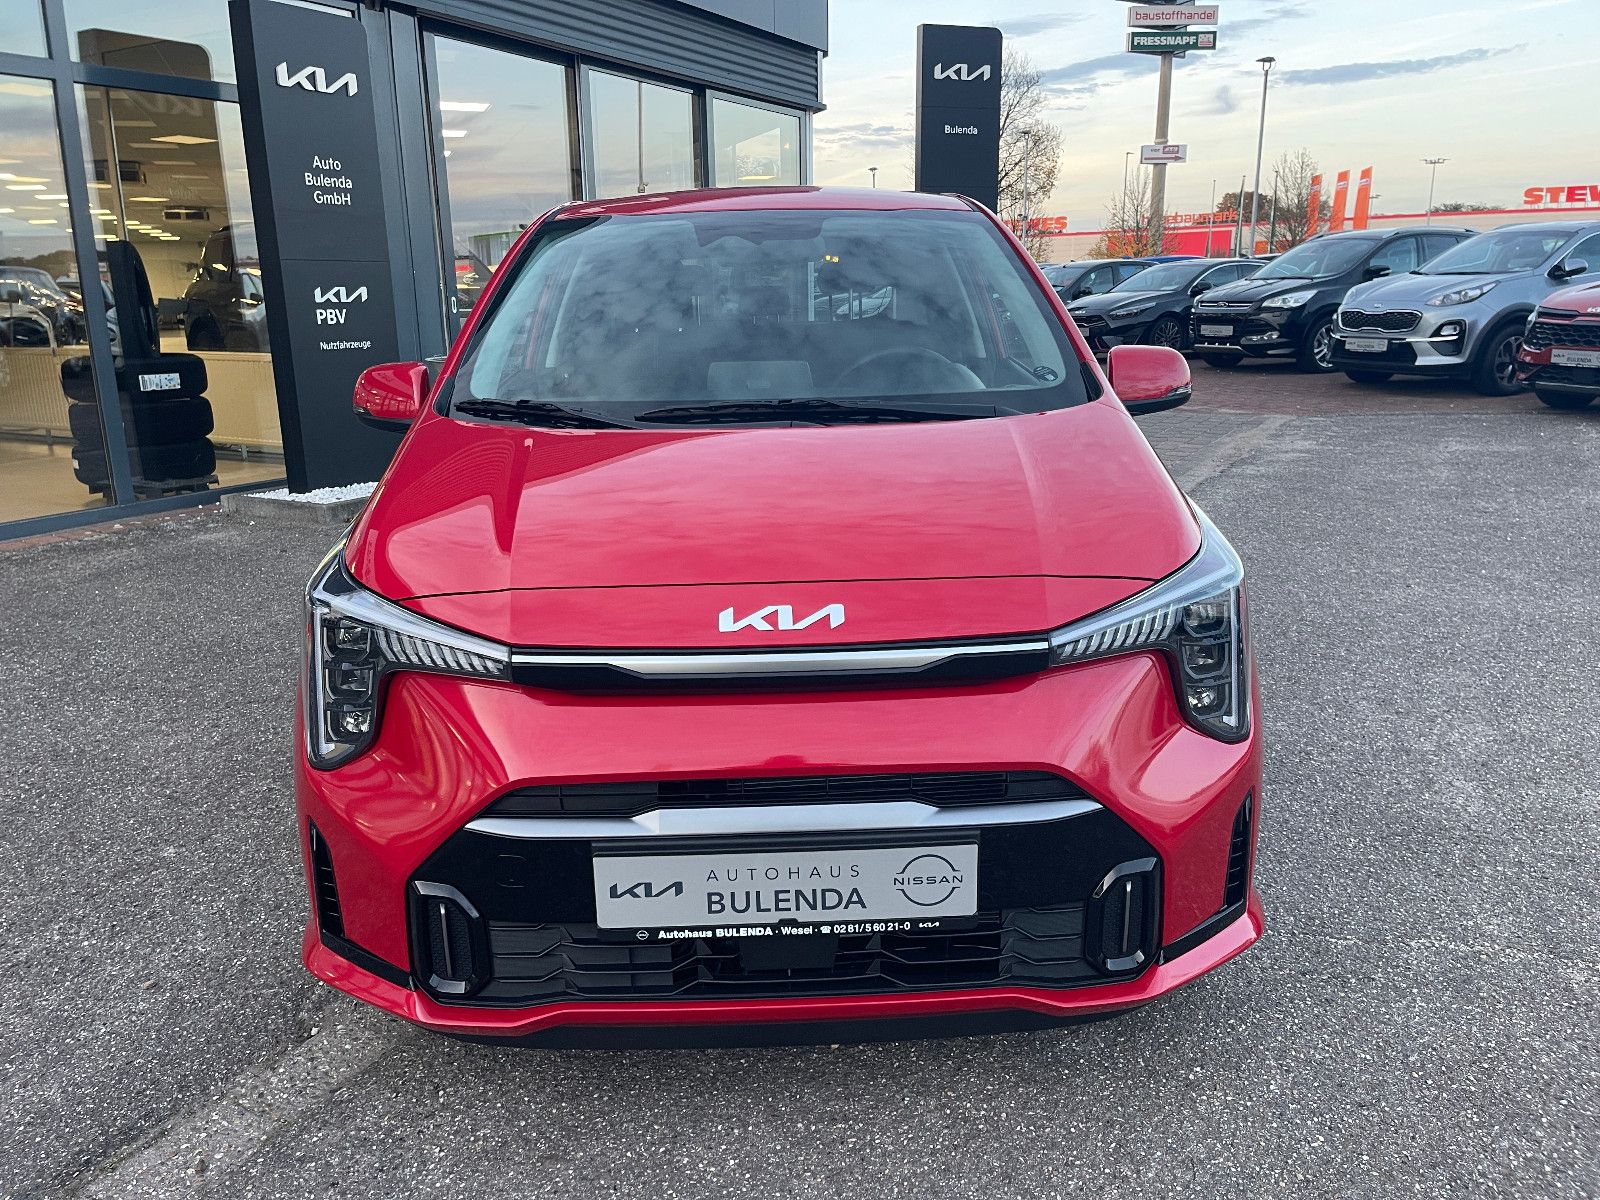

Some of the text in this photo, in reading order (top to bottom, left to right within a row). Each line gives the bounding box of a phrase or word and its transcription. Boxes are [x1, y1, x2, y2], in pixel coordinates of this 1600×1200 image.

[1135, 10, 1216, 20] baustoffhandel
[1133, 36, 1197, 46] FRESSNAPF
[275, 61, 358, 97] KIA
[933, 62, 991, 81] KIA
[944, 125, 978, 135] Bulenda
[312, 155, 342, 171] Auto
[304, 172, 353, 189] Bulenda
[313, 190, 352, 206] GmbH
[314, 286, 368, 303] KIA
[315, 308, 347, 325] PBV
[319, 340, 372, 351] Nutzfahrzeuge
[718, 603, 845, 632] KIA
[706, 864, 860, 882] AUTOHAUS
[893, 875, 963, 886] NISSAN
[609, 881, 684, 899] KIA
[706, 887, 867, 914] BULENDA
[658, 930, 713, 939] Autohaus
[716, 928, 773, 938] BULENDA
[781, 924, 813, 935] Wesel
